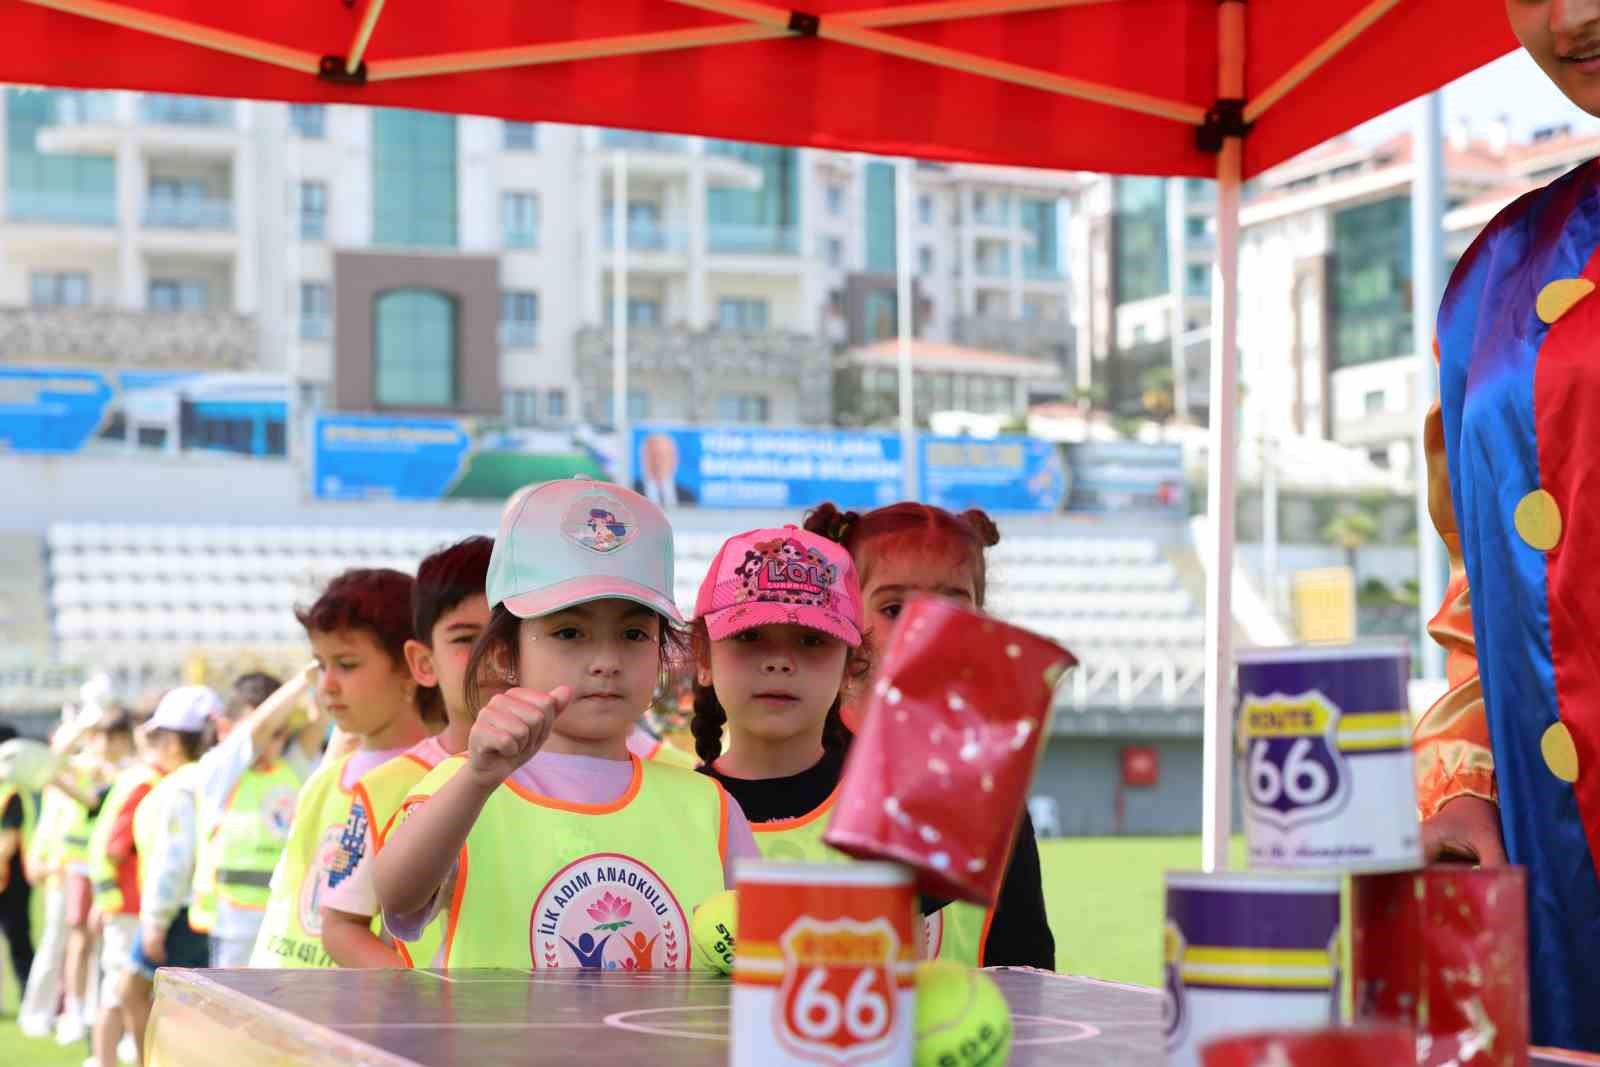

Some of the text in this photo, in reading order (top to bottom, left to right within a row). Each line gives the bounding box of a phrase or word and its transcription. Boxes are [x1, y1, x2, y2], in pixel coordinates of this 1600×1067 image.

[1250, 711, 1314, 728] ROUTE
[1250, 738, 1329, 804] 66
[538, 866, 669, 935] İLK ADIM ANAOKULU
[794, 967, 888, 1039] 66
